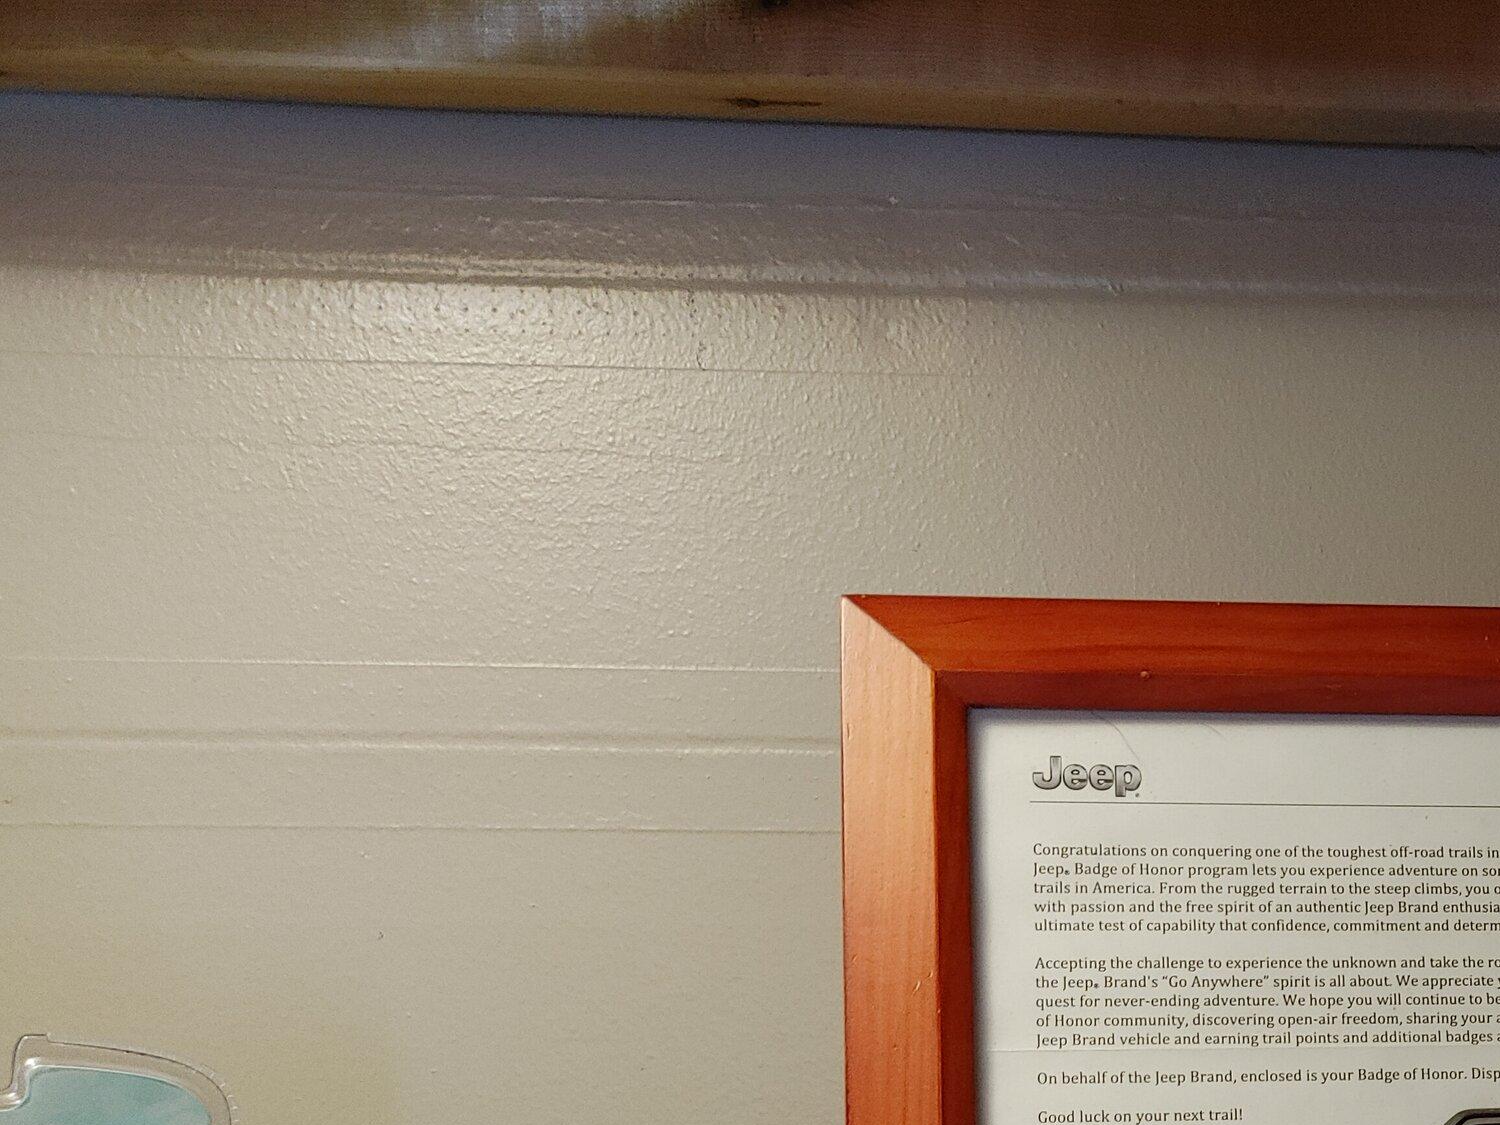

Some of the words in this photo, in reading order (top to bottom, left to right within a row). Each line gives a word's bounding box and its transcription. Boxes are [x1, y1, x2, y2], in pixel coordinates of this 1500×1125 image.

[1032, 755, 1142, 798] Jeep
[1032, 842, 1148, 860] Congratulations
[1150, 847, 1169, 857] on
[1171, 844, 1253, 861] conquering
[1254, 848, 1282, 858] one
[1283, 845, 1298, 858] of
[1301, 844, 1324, 858] the
[1326, 844, 1388, 862] toughest
[1389, 845, 1445, 859] off-road
[1448, 845, 1484, 859] trails
[1486, 846, 1500, 859] in
[1034, 918, 1095, 932] ultimate
[1098, 920, 1125, 932] test
[1128, 918, 1145, 932] of
[1145, 918, 1216, 935] capability
[1219, 918, 1248, 932] that
[1250, 918, 1331, 934] confidence,
[1332, 919, 1422, 932] commitment
[1423, 918, 1450, 932] and
[1035, 1013, 1052, 1028] of
[1054, 1013, 1101, 1028] Honor
[1103, 1015, 1189, 1030] community,
[1191, 1012, 1276, 1029] discovering
[1277, 1012, 1339, 1029] open-air
[1341, 1011, 1404, 1027] freedom,
[1405, 1011, 1459, 1028] sharing
[1460, 1014, 1494, 1028] your
[1037, 1109, 1076, 1124] Good
[1079, 1109, 1111, 1124] luck
[1113, 1112, 1132, 1123] on
[1135, 1112, 1171, 1125] your
[1173, 1109, 1206, 1122] next
[1208, 1107, 1243, 1122] trail!
